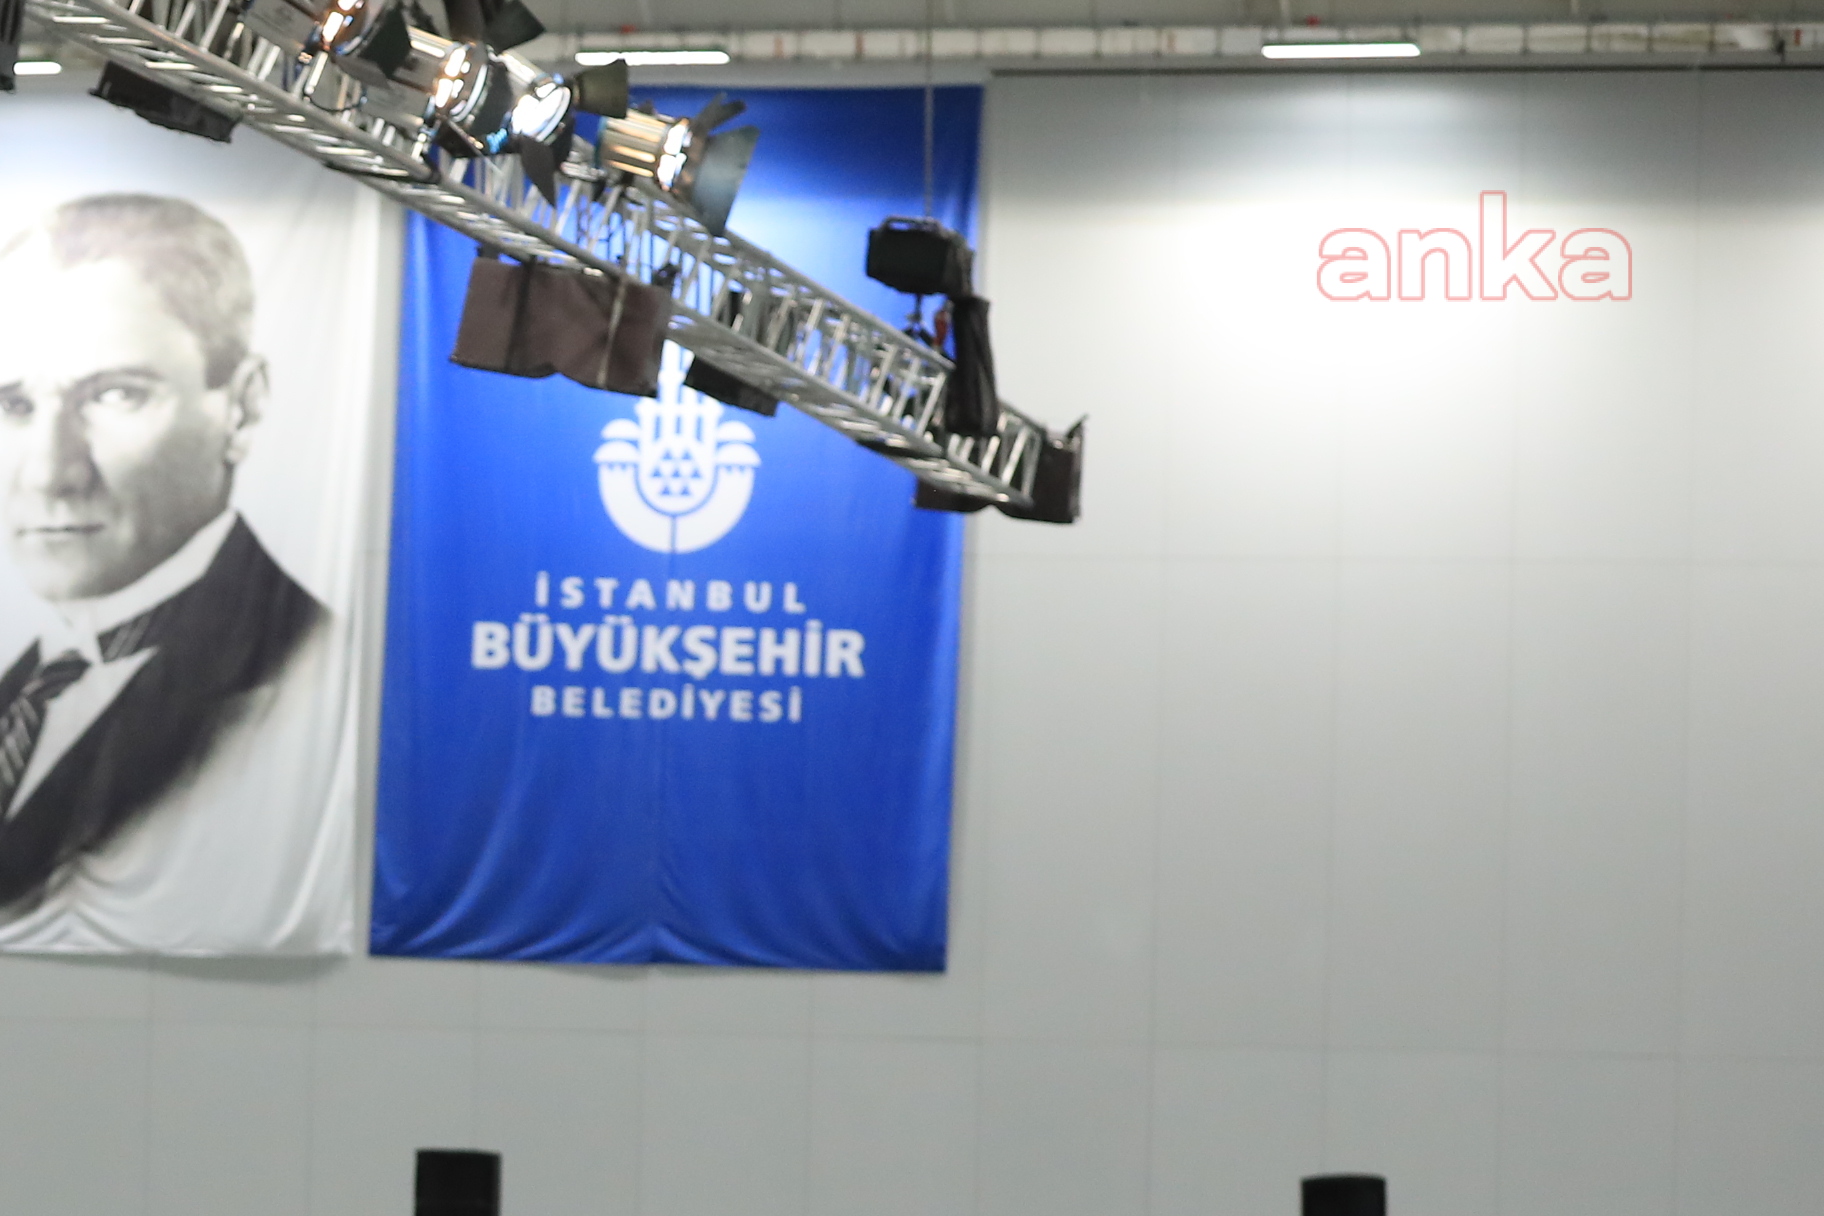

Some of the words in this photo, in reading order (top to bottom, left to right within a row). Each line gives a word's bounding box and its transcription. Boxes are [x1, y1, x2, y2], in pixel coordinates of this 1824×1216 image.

[534, 571, 805, 613] İSTANBUL
[471, 613, 865, 680] BÜYÜKŞEHİR
[531, 684, 801, 722] BELEDİYESİ
